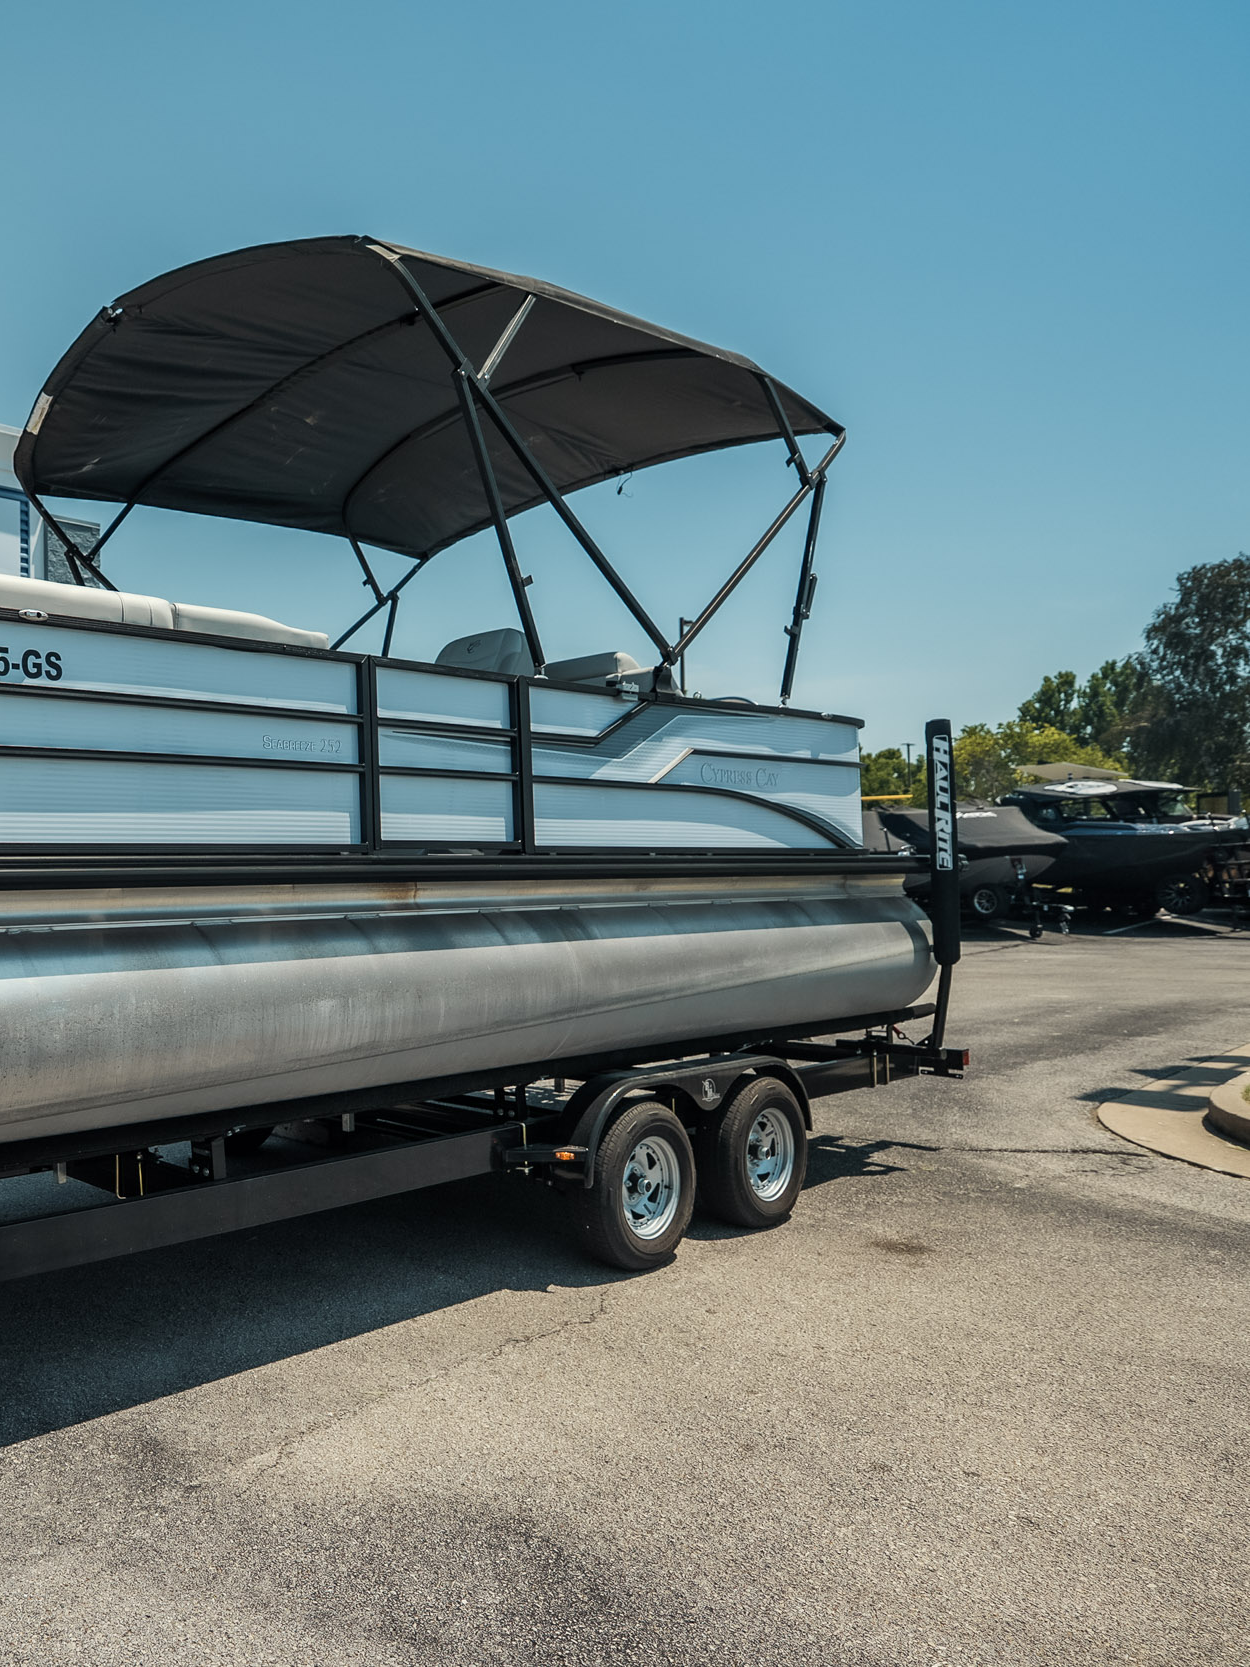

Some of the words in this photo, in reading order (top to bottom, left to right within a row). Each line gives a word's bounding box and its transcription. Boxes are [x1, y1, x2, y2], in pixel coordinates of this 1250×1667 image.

[320, 739, 342, 754] 252
[700, 762, 752, 786] CYPRESS
[755, 767, 781, 789] CAY
[933, 735, 953, 870] HAULRITE
